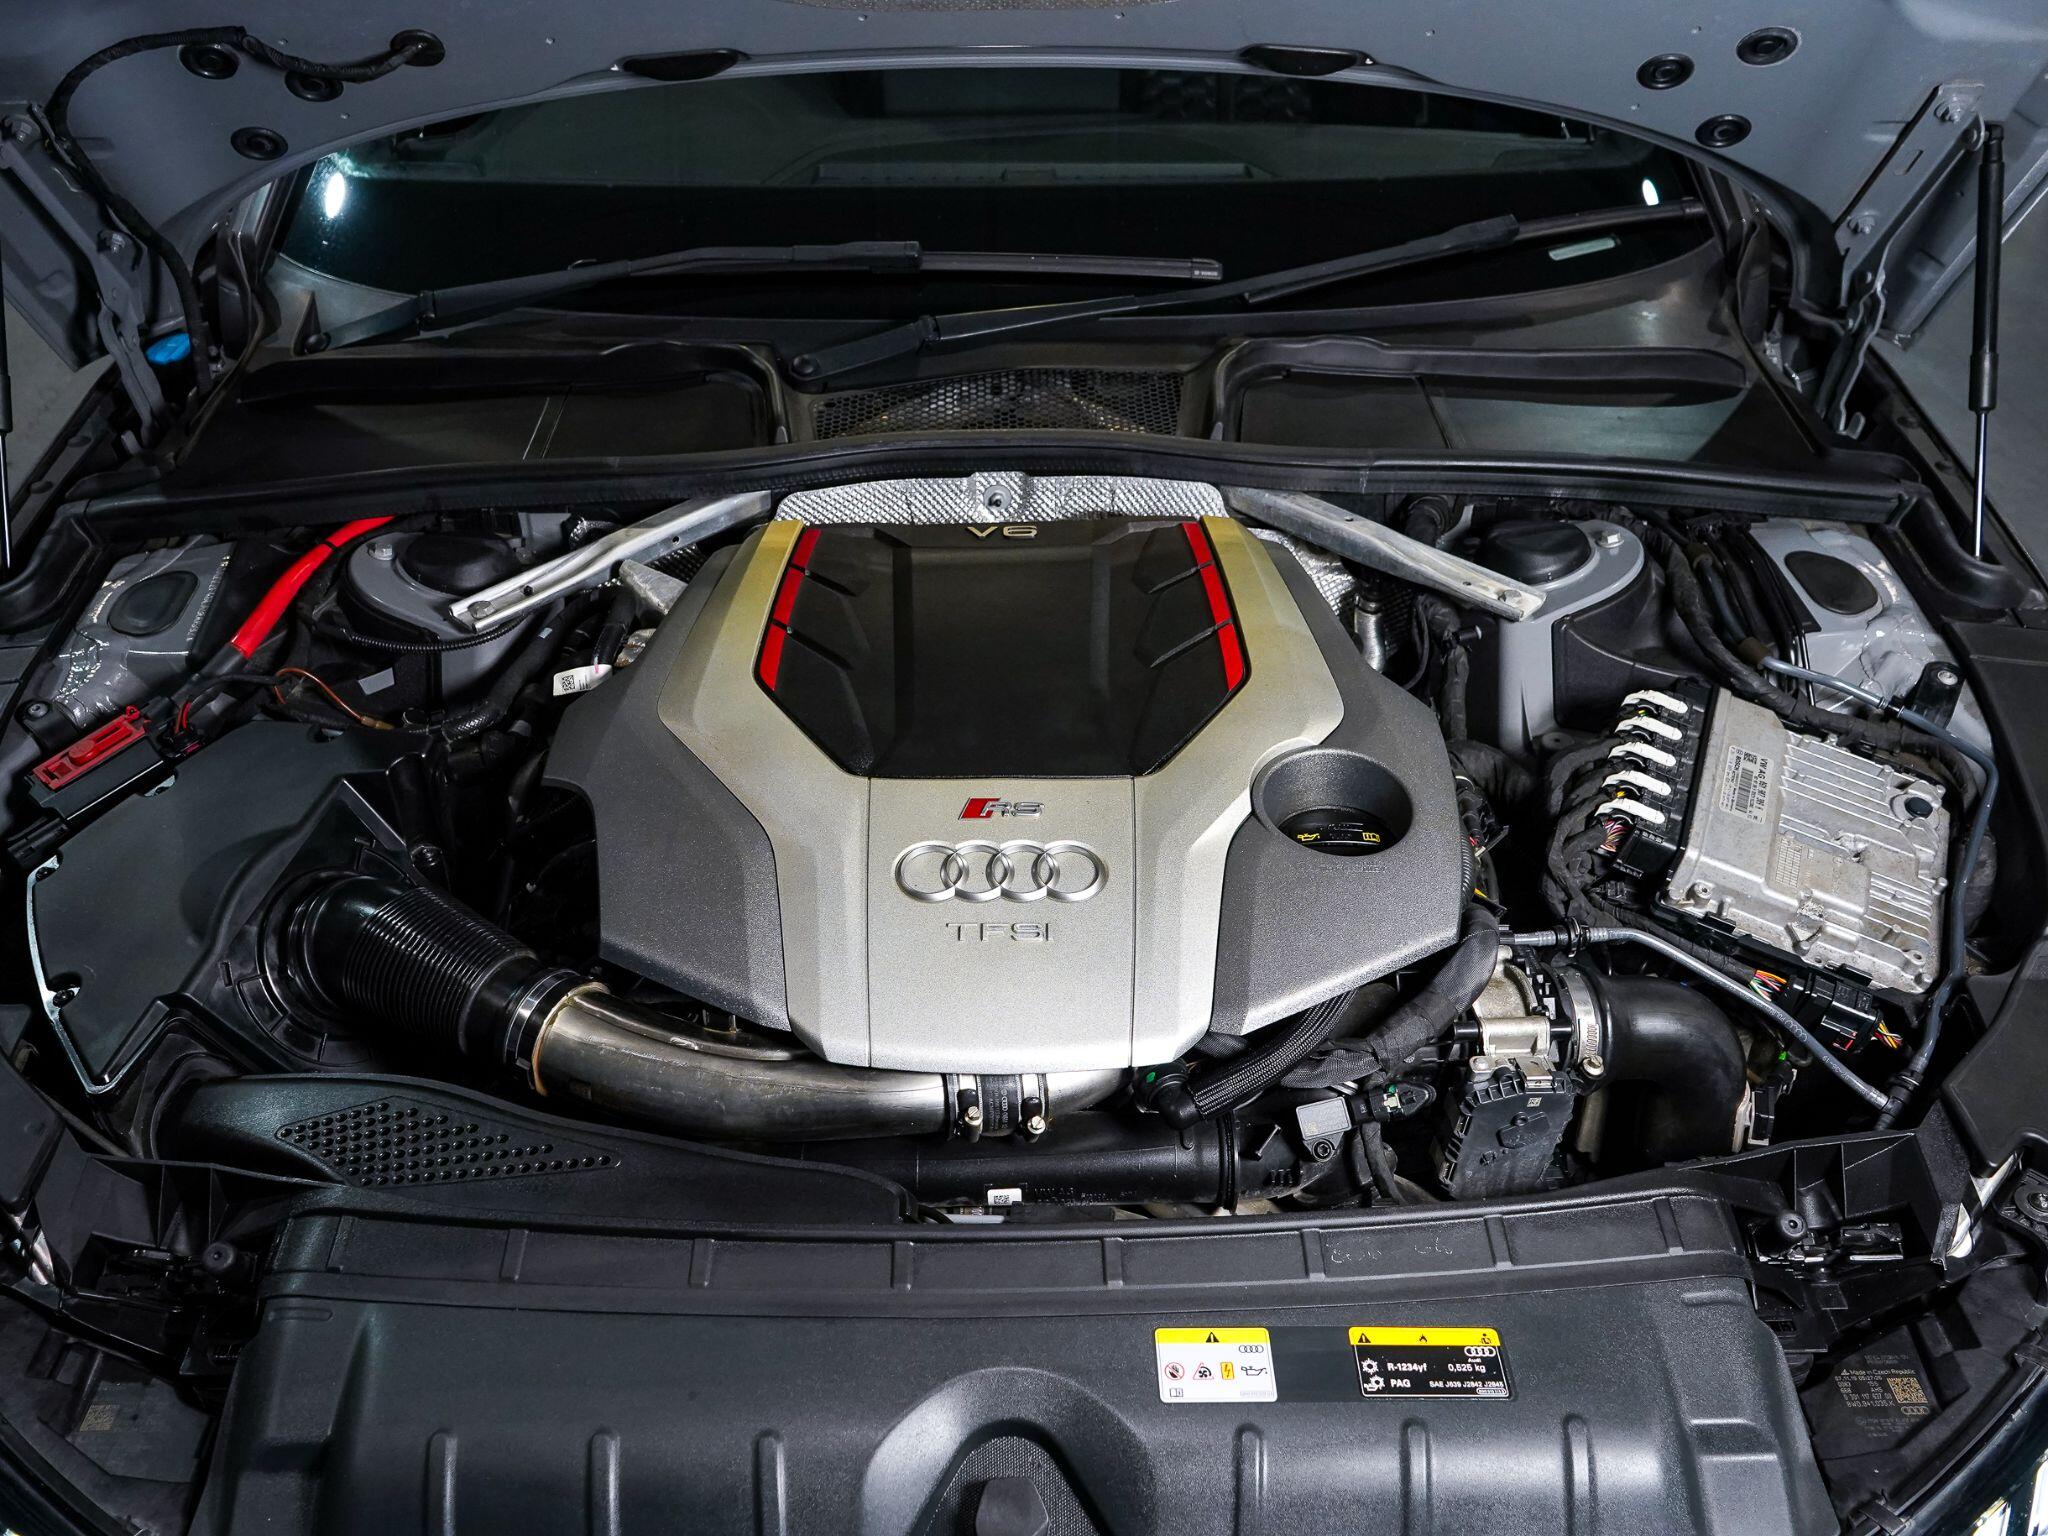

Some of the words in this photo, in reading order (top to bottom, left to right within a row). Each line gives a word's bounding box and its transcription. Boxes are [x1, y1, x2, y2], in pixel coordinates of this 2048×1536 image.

[966, 525, 1038, 538] V6
[1760, 758, 1768, 769] VW
[1757, 769, 1766, 780] AG
[978, 800, 1045, 817] RS
[946, 923, 1054, 942] TFSI
[1387, 1362, 1428, 1373] R-1234yf
[1447, 1363, 1473, 1373] 0,525
[1474, 1363, 1486, 1374] kg
[1390, 1379, 1411, 1388] PAG
